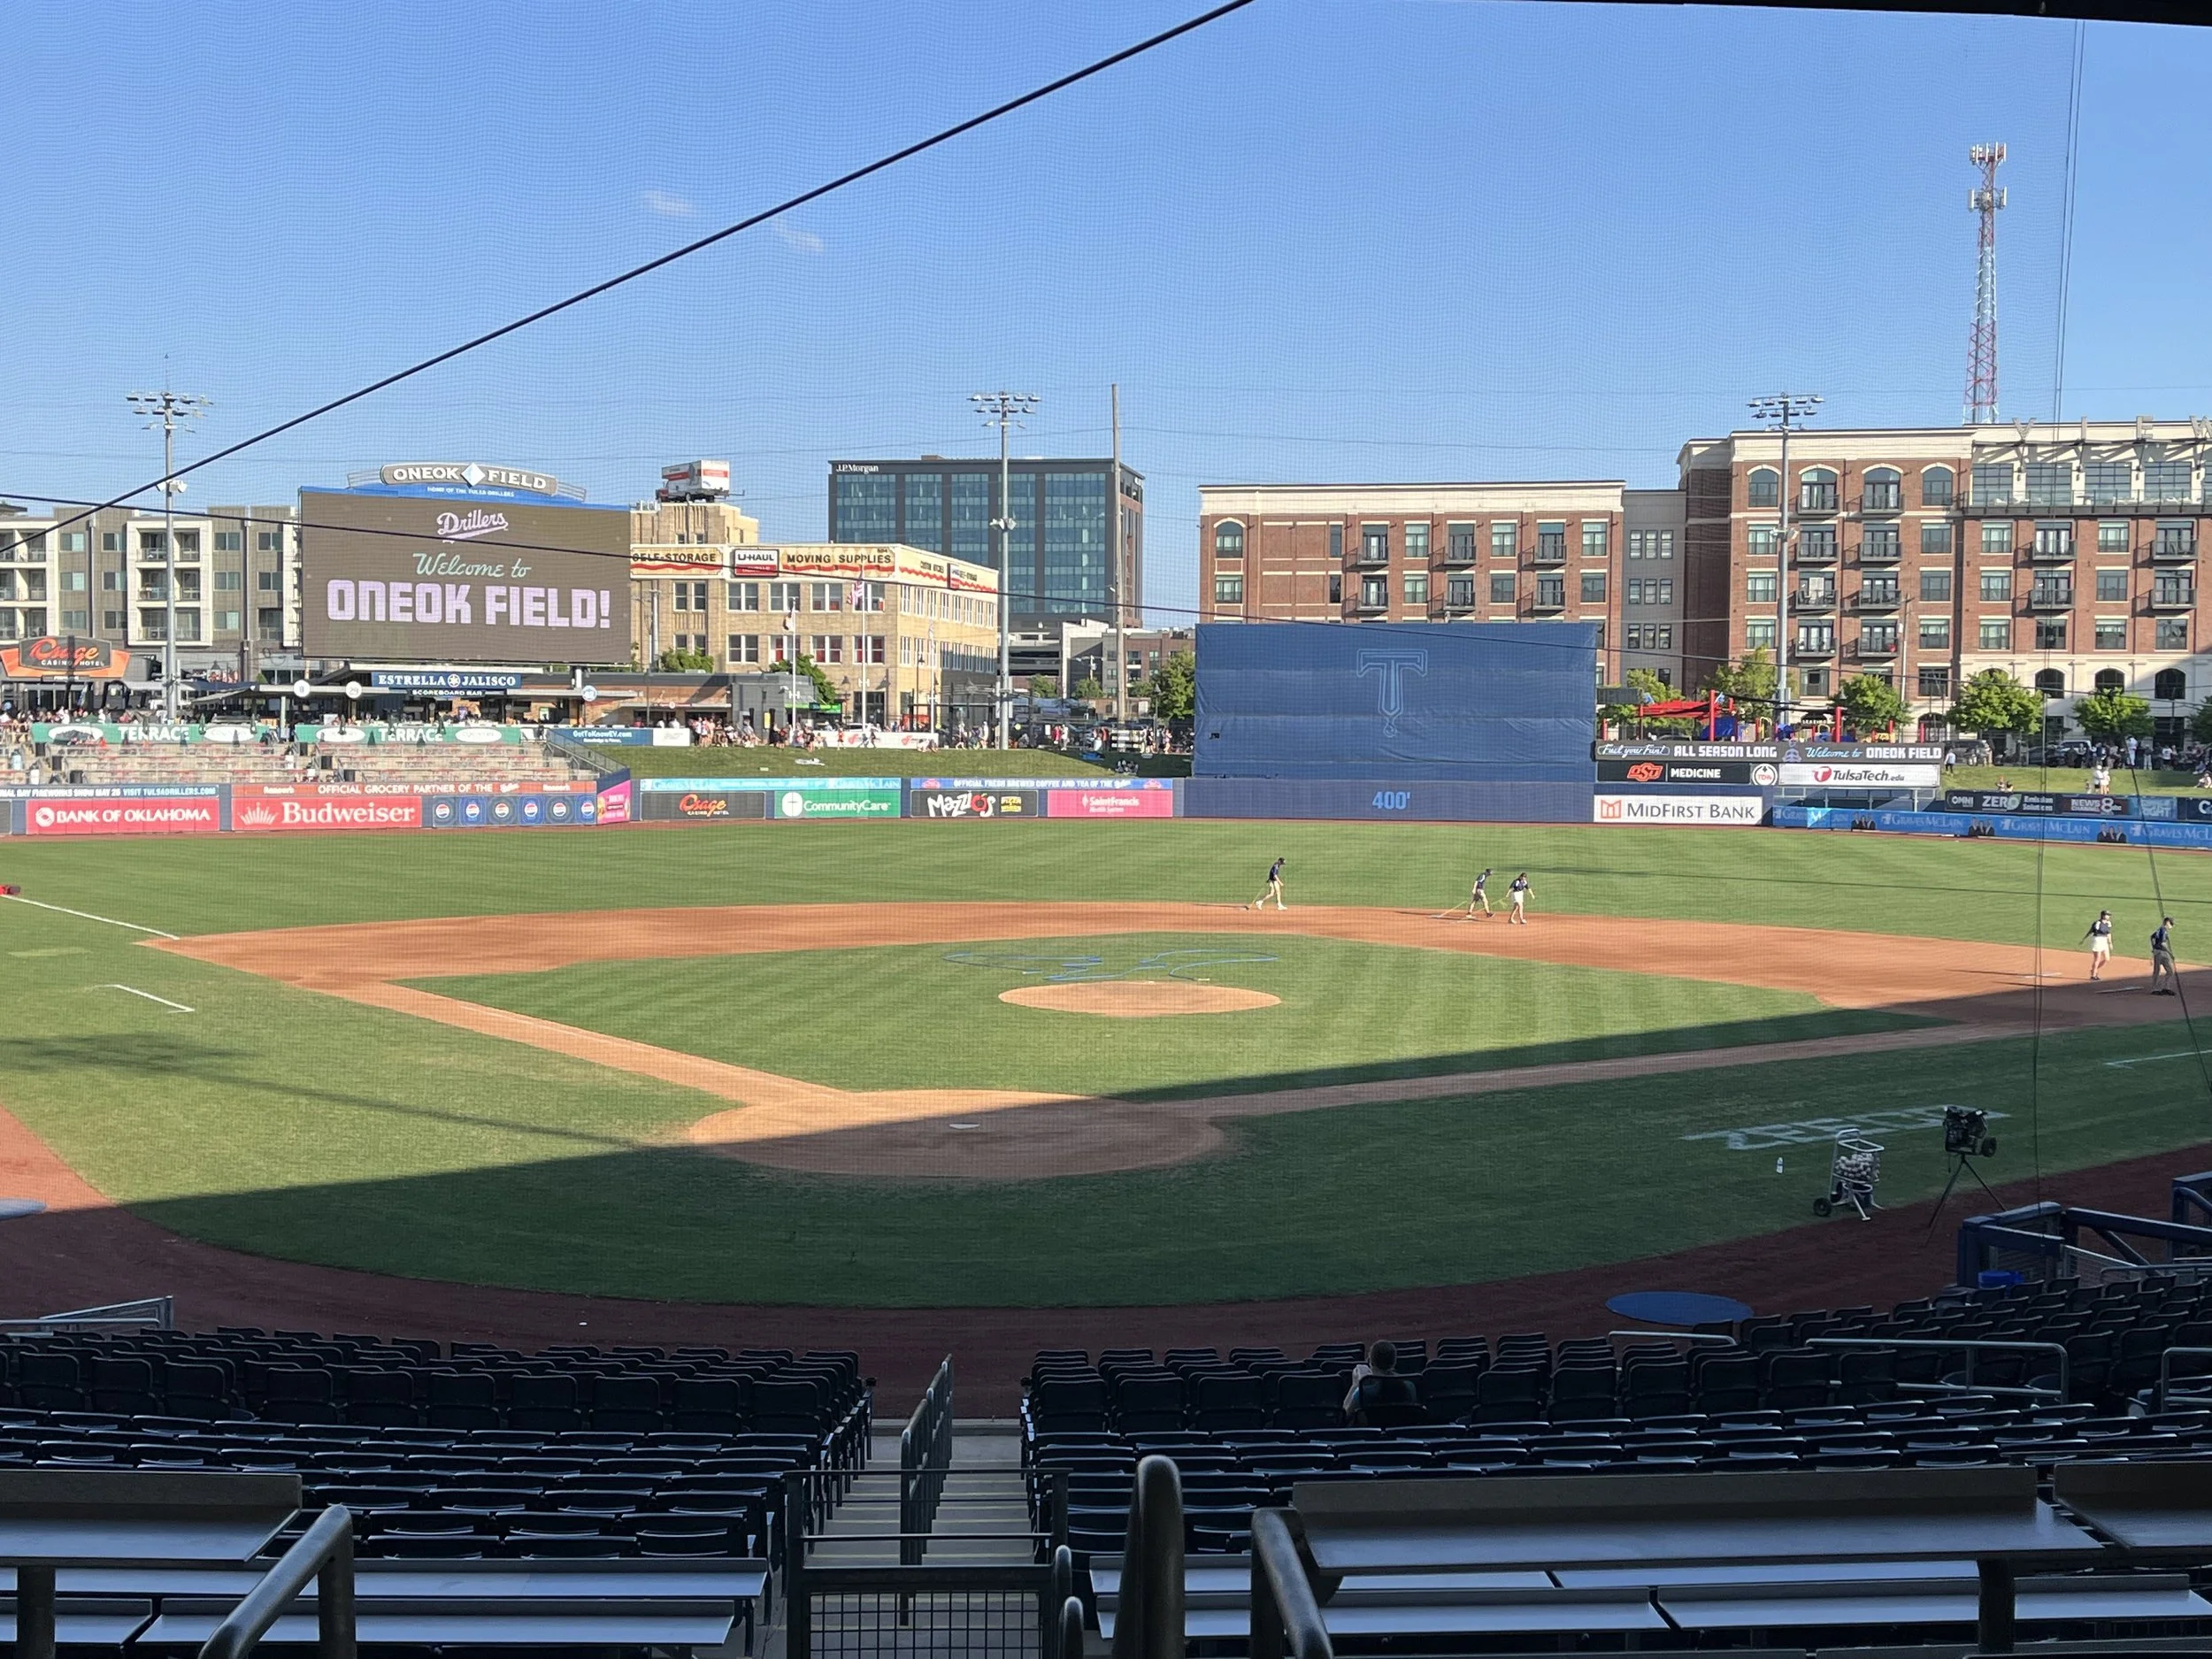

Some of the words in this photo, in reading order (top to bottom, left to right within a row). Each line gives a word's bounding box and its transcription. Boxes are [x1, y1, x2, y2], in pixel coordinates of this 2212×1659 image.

[393, 467, 459, 480] ONEOK
[488, 469, 547, 489] FIELD
[437, 509, 509, 538] Drillers
[412, 552, 505, 578] Welcome
[511, 557, 532, 578] to
[787, 554, 831, 564] MOVING
[326, 580, 472, 624] ONEOK
[485, 585, 611, 628] FIELD!
[378, 674, 446, 686] ESTRELLA
[461, 676, 516, 686] JALISCO
[1674, 746, 1696, 757] ALL
[1699, 746, 1744, 757] SEASON
[1746, 747, 1778, 758] LONG
[1805, 746, 1851, 758] Welcome
[1866, 747, 1907, 758] ONEOK
[1909, 748, 1942, 758] FIELD
[1670, 767, 1722, 779] MEDICINE
[318, 784, 362, 795] OFFICIAL
[365, 784, 410, 795] GROCERY
[413, 783, 455, 794] PARTNER
[457, 783, 472, 793] OF
[475, 783, 493, 793] THE
[280, 801, 416, 824] Budweiser
[680, 794, 726, 818] Osage
[803, 799, 889, 813] CommunityCare
[56, 810, 100, 824] BANK
[102, 809, 121, 823] OF
[124, 808, 211, 823] OKLAHOMA
